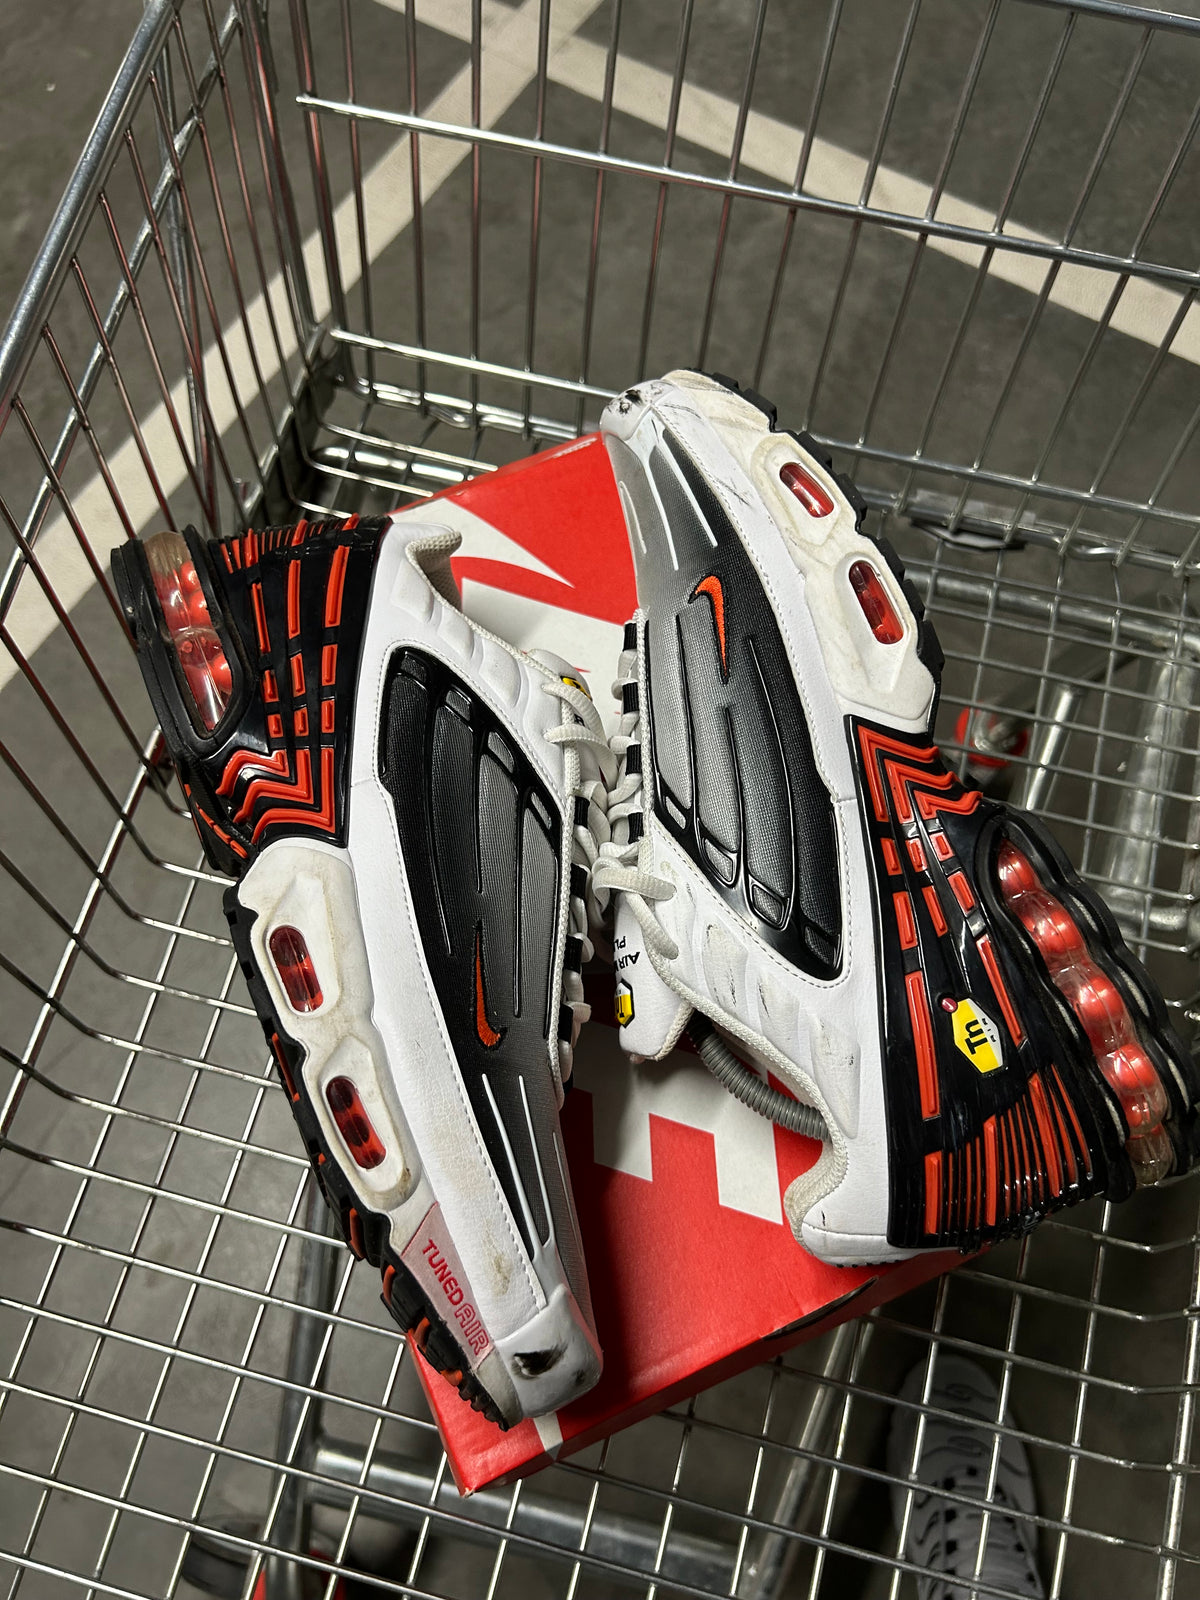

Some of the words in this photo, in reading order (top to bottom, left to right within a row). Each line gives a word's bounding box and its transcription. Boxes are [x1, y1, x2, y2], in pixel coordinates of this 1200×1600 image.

[965, 1019, 989, 1055] Tn
[422, 1238, 464, 1306] TUNED
[454, 1303, 490, 1356] AIR
